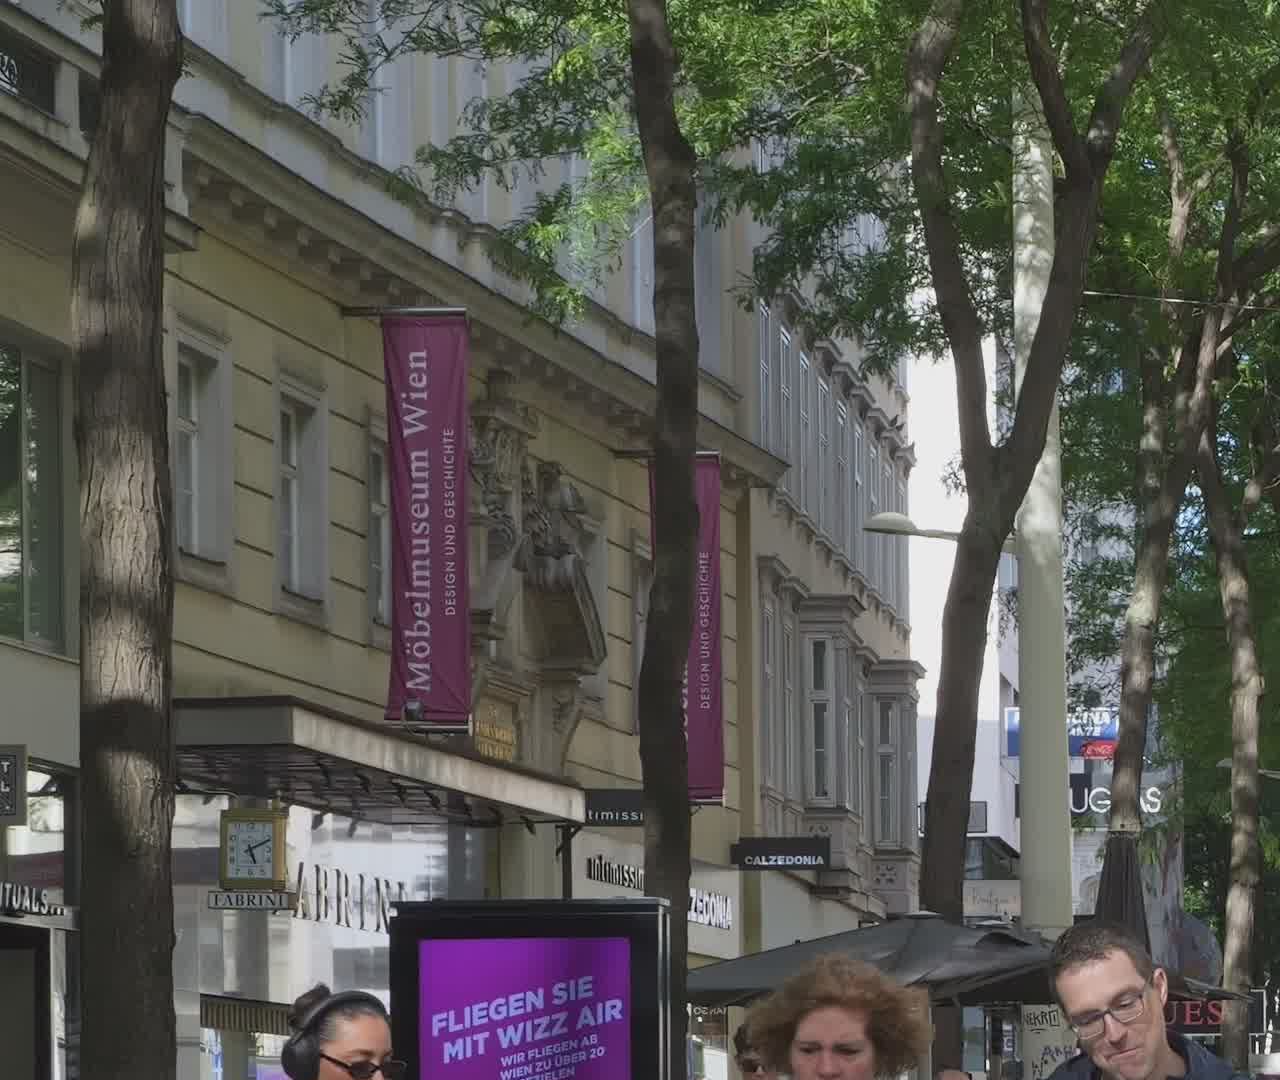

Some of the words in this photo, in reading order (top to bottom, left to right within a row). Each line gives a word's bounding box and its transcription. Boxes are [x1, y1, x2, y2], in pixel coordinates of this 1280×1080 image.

[401, 349, 428, 438] Wien
[443, 428, 455, 519] GESCHICHTE
[445, 524, 456, 558] UND
[405, 449, 431, 692] Möbelmuseum
[445, 561, 456, 615] DESIGN
[699, 551, 710, 627] GESCHICHTE
[700, 632, 711, 658] UND
[700, 663, 710, 709] DESIGN
[745, 855, 825, 866] CALZEDONIA
[688, 888, 732, 930] ZEDONIA
[432, 988, 544, 1037] FLIEGEN
[552, 976, 593, 1005] SIE
[443, 1032, 490, 1064] MIT
[497, 1011, 568, 1048] WIZZ
[576, 999, 623, 1031] AIR
[500, 1065, 532, 1080] WIEN
[535, 1059, 551, 1071] ZU
[555, 1051, 587, 1066] ÜBER
[589, 1047, 605, 1058] 20
[501, 1052, 525, 1067] WIR
[528, 1039, 578, 1060] FLIEGEN
[581, 1034, 598, 1046] AB
